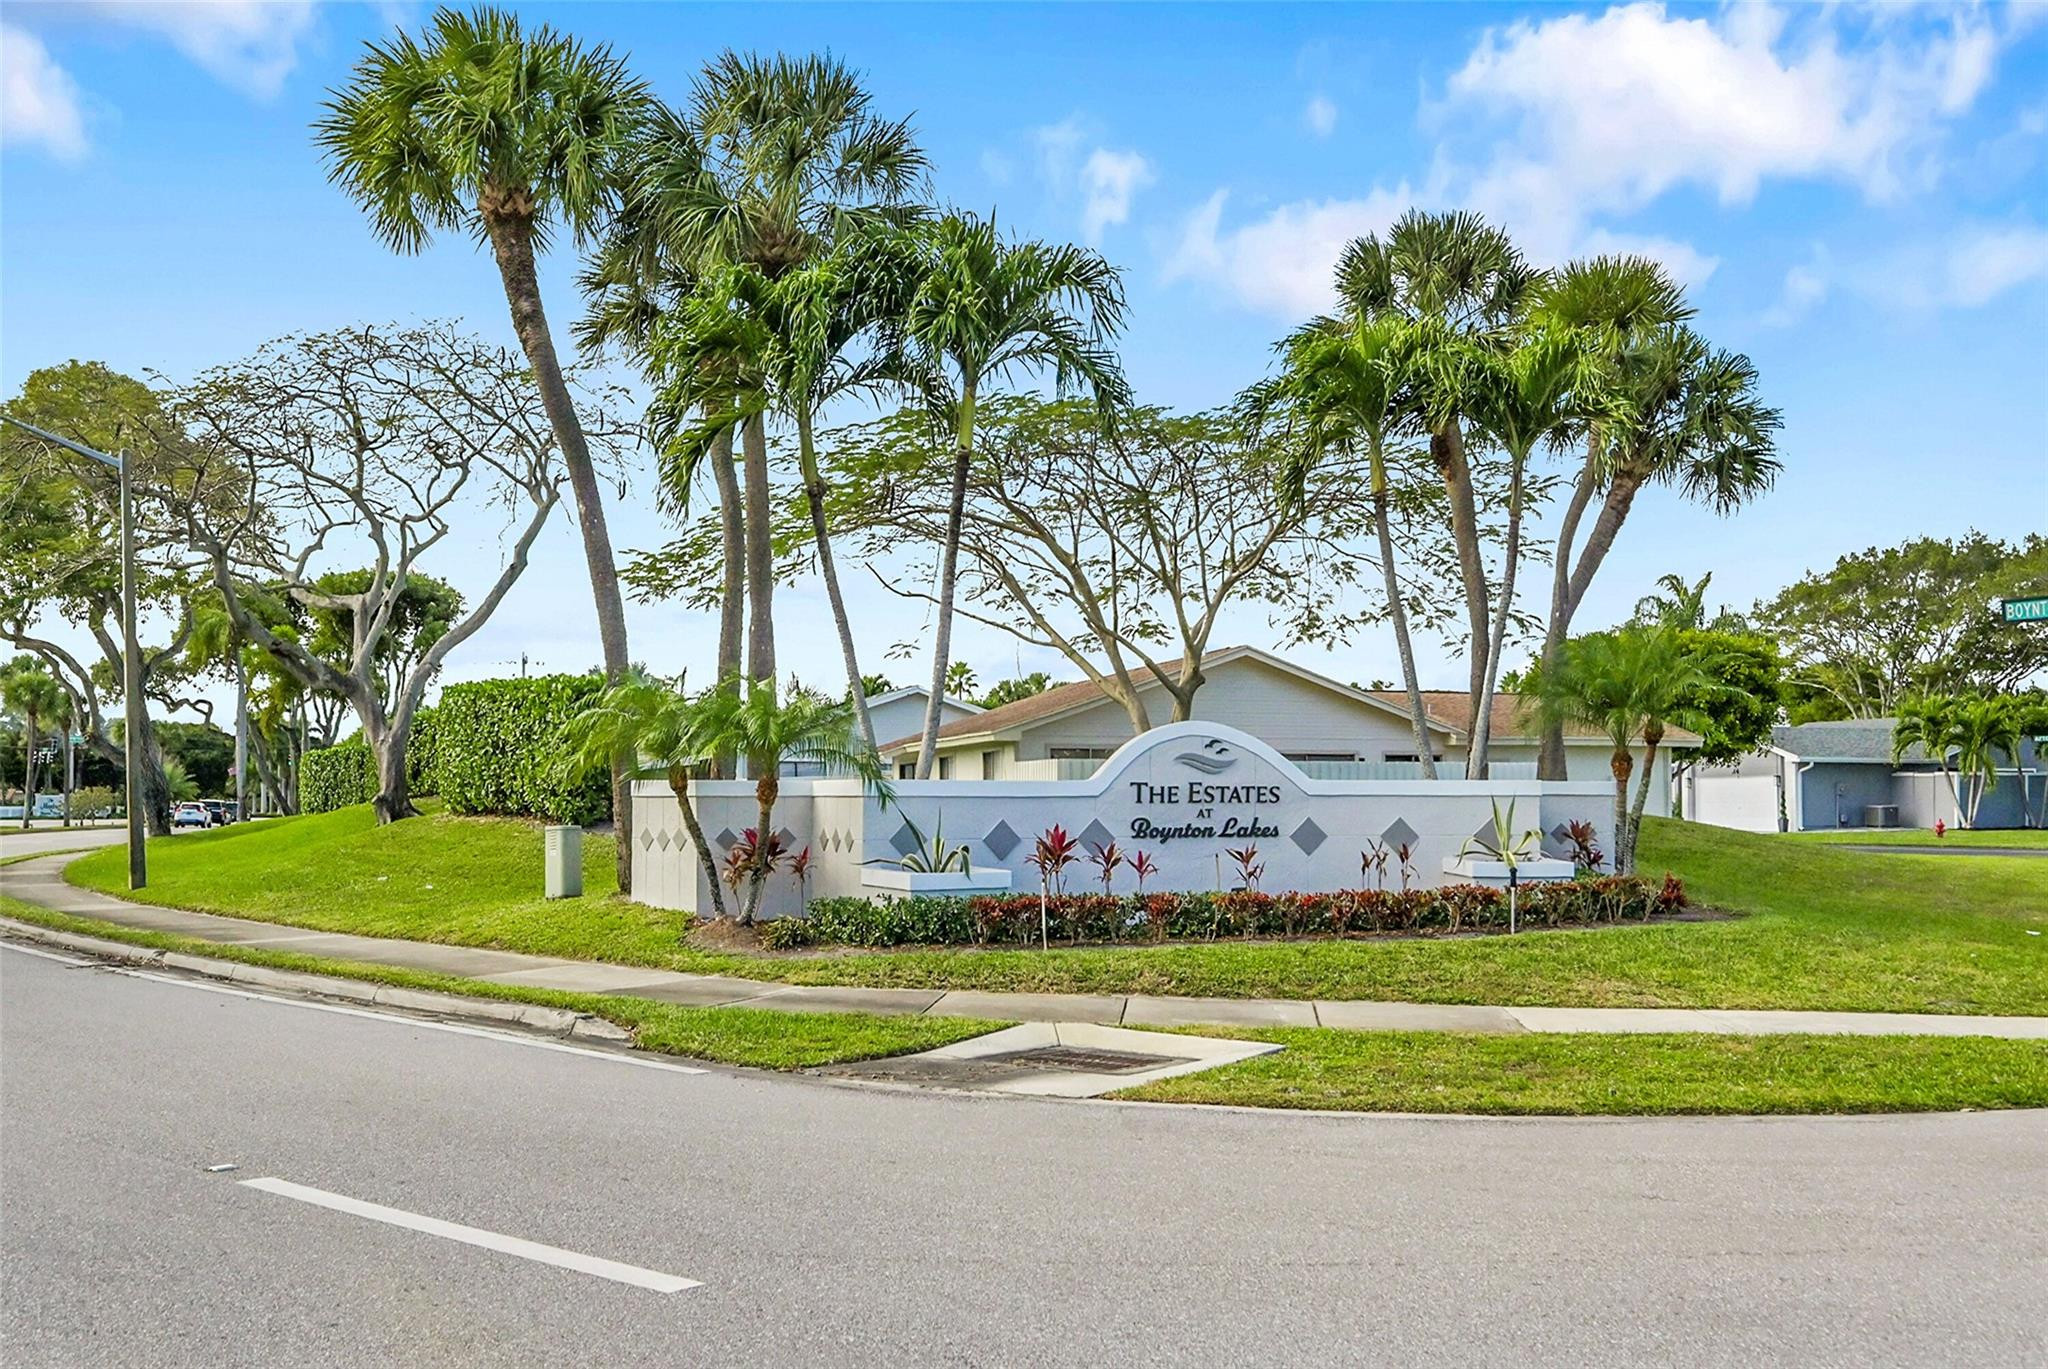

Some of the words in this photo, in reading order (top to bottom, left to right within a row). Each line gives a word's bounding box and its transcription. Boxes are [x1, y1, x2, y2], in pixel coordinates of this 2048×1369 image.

[1130, 782, 1179, 804] THE
[1188, 782, 1280, 804] ESTATES
[1196, 809, 1213, 818] AT
[1131, 818, 1216, 844] Boynton
[1218, 817, 1279, 838] Lakes
